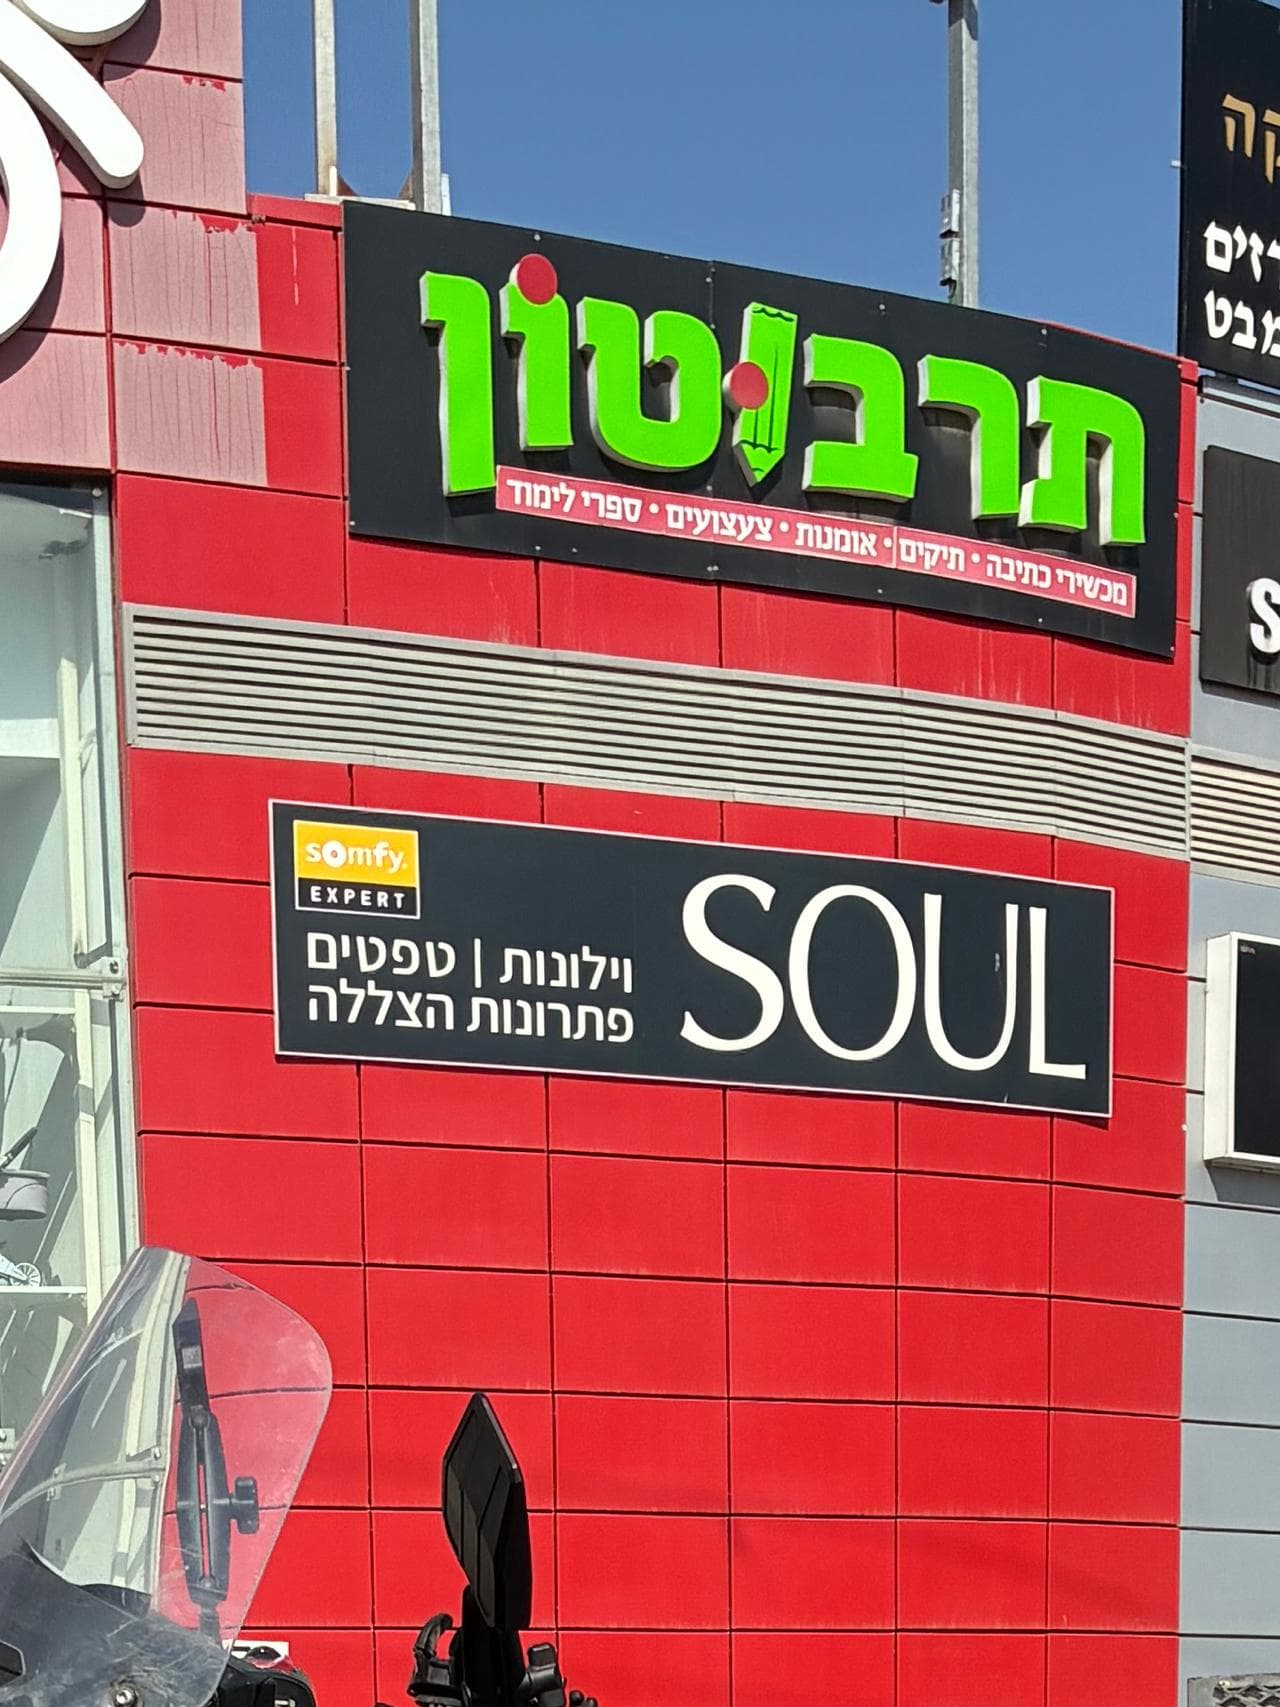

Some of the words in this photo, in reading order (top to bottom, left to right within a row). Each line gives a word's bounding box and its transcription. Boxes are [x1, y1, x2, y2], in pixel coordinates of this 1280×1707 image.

[505, 474, 575, 514] לימוד
[581, 488, 642, 525] ספרי
[666, 501, 773, 543] צעצועים
[796, 520, 878, 559] אומנות
[899, 537, 966, 574] תיקים
[984, 551, 1052, 590] כתיבה
[1055, 570, 1127, 608] מכשירי
[304, 838, 406, 874] somfy
[310, 886, 407, 909] EXPERT
[307, 930, 456, 979] טפטים
[500, 946, 634, 994] וילונות
[680, 873, 1088, 1081] SOUL
[307, 977, 455, 1032] הצללה
[467, 992, 634, 1044] פתרונות
